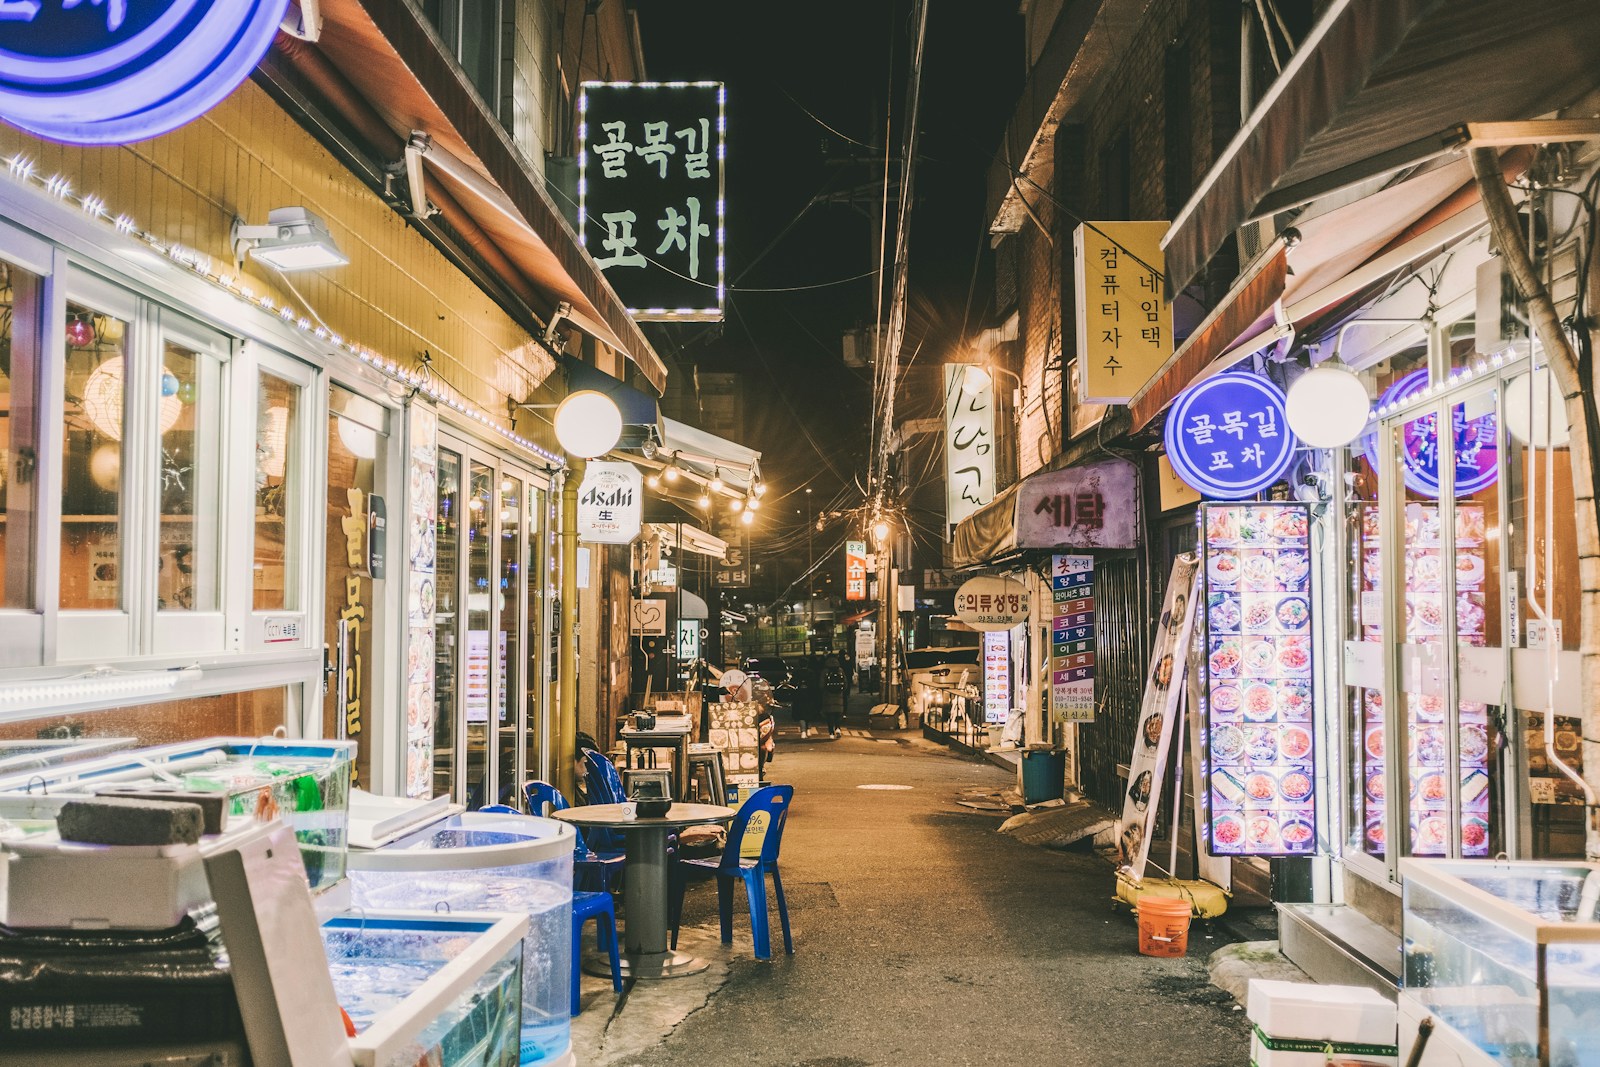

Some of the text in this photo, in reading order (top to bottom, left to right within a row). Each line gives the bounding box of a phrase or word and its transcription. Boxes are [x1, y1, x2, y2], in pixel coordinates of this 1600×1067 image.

[593, 117, 710, 179] 골목길
[593, 197, 710, 279] 포차
[1100, 247, 1122, 376] 컴퓨터자수
[1139, 272, 1160, 349] 네임택
[1186, 405, 1278, 444] 골목길
[1208, 443, 1265, 472] 포차
[581, 486, 632, 507] Asahi
[1034, 493, 1106, 529] 세탁
[598, 510, 613, 521] 生
[849, 544, 863, 553] 우리
[1072, 559, 1090, 570] 수선
[848, 560, 864, 597] 슈퍼
[341, 487, 366, 735] 골목길
[966, 593, 1019, 613] 의류성형
